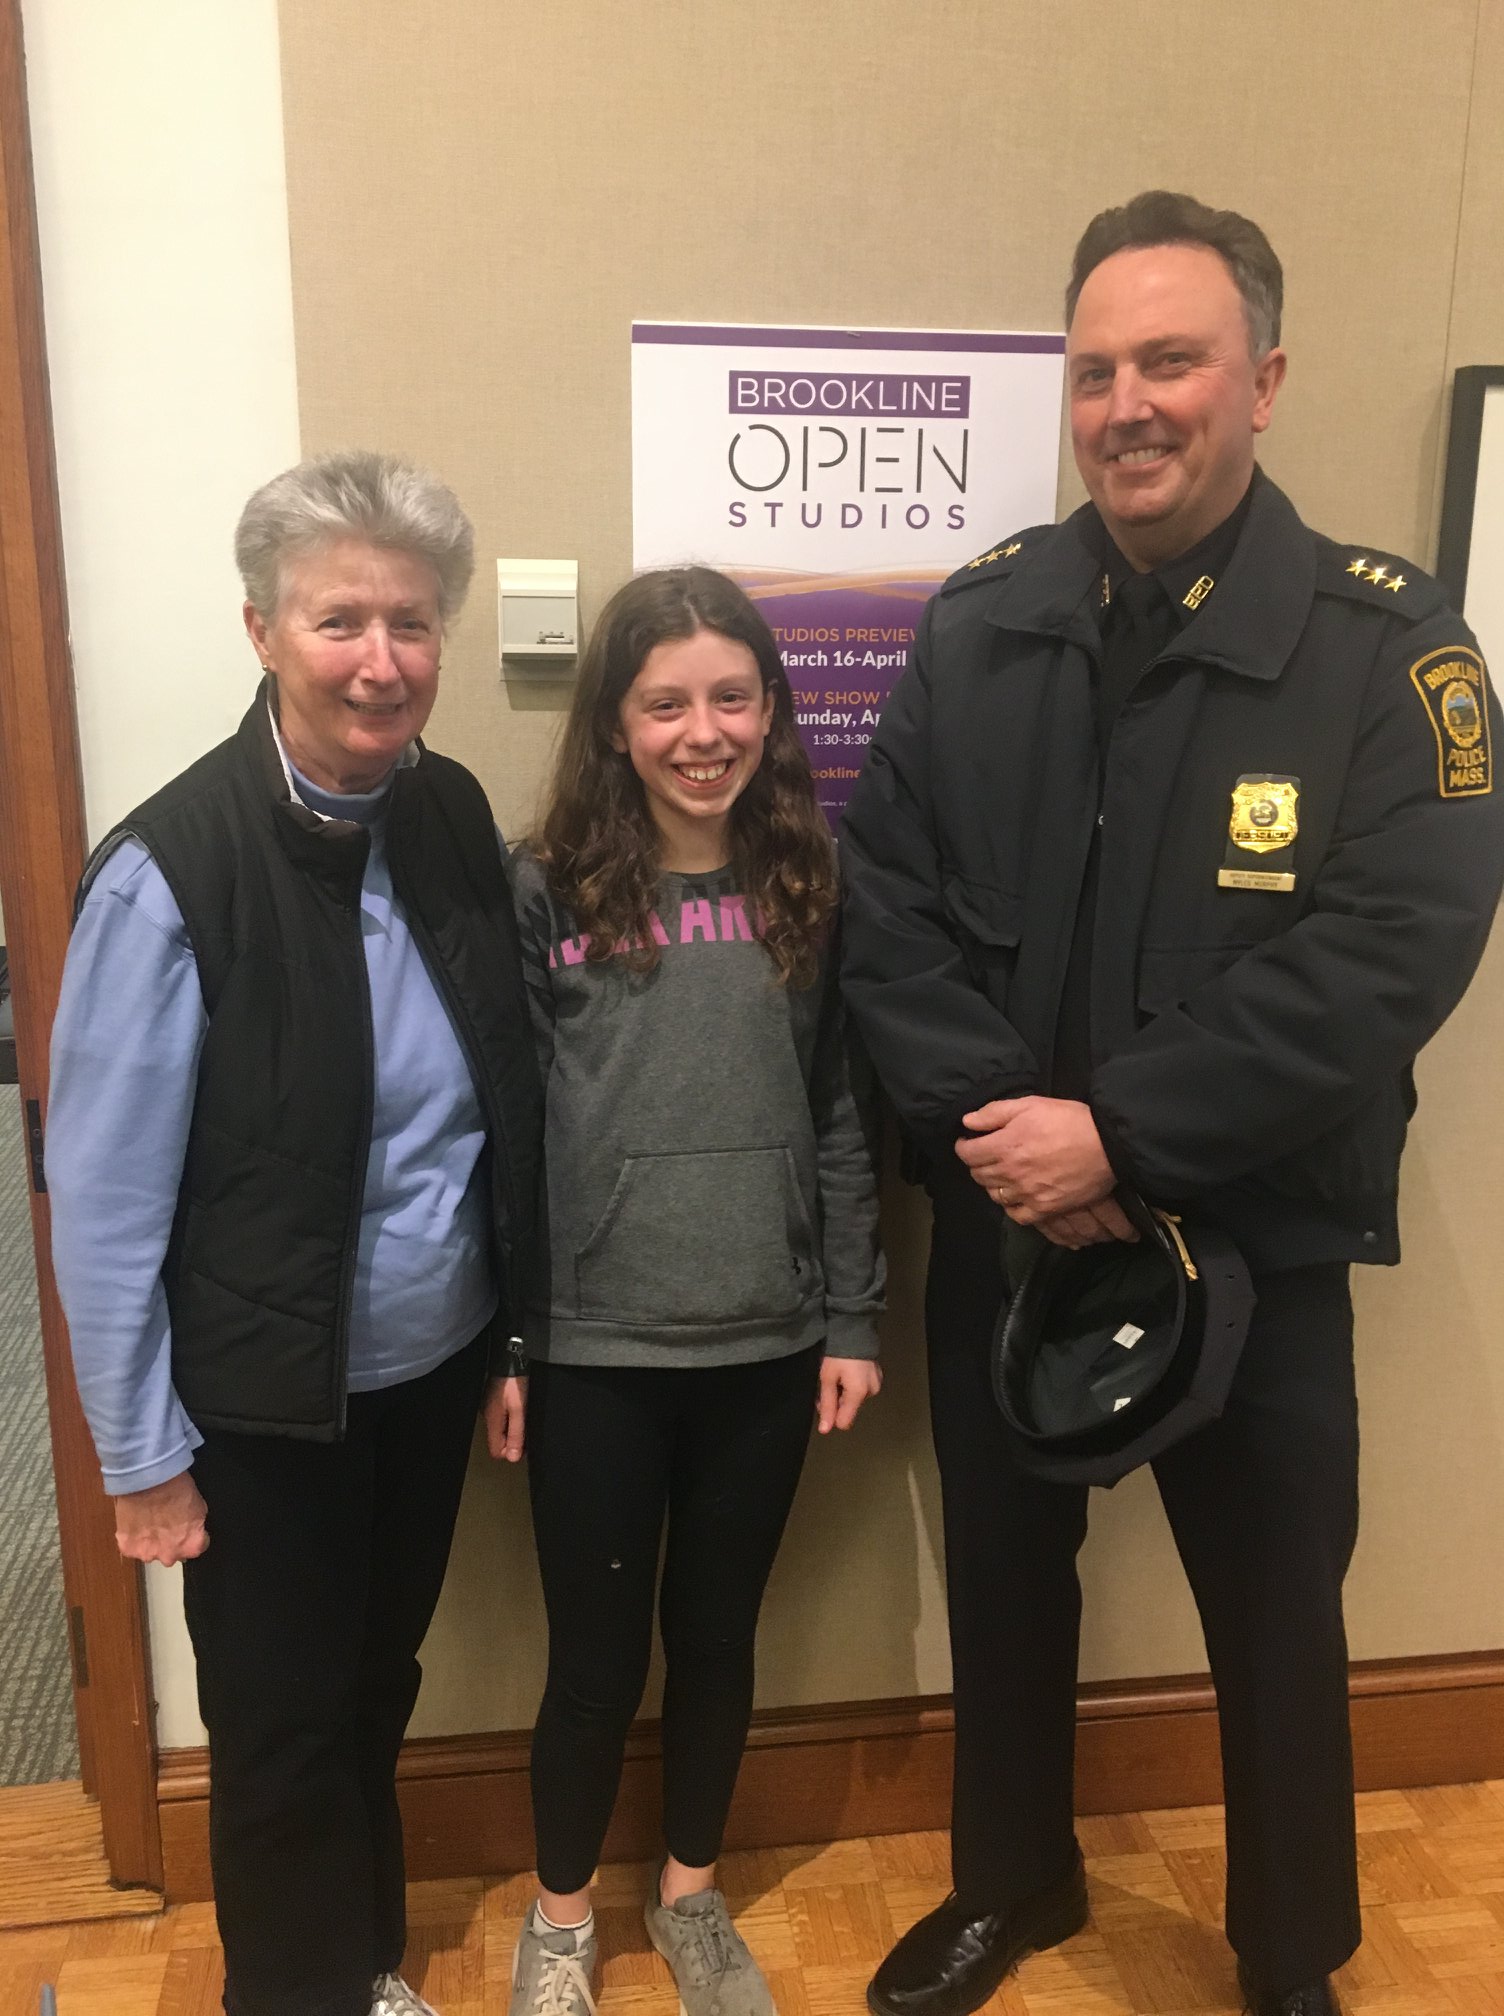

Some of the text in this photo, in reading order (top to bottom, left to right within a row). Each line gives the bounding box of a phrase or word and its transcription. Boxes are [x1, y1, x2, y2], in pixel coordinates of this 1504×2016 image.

[737, 377, 962, 411] BROOKLINE
[728, 423, 969, 493] OPEN
[728, 501, 966, 530] STUDIOS
[772, 628, 840, 642] TUDIOS
[833, 650, 907, 670] 16-April
[1423, 661, 1480, 690] BROOKLINE
[824, 691, 880, 705] SHOW
[793, 709, 857, 728] unday,
[813, 734, 872, 745] 1:30-3:30
[1447, 745, 1486, 768] POLICE
